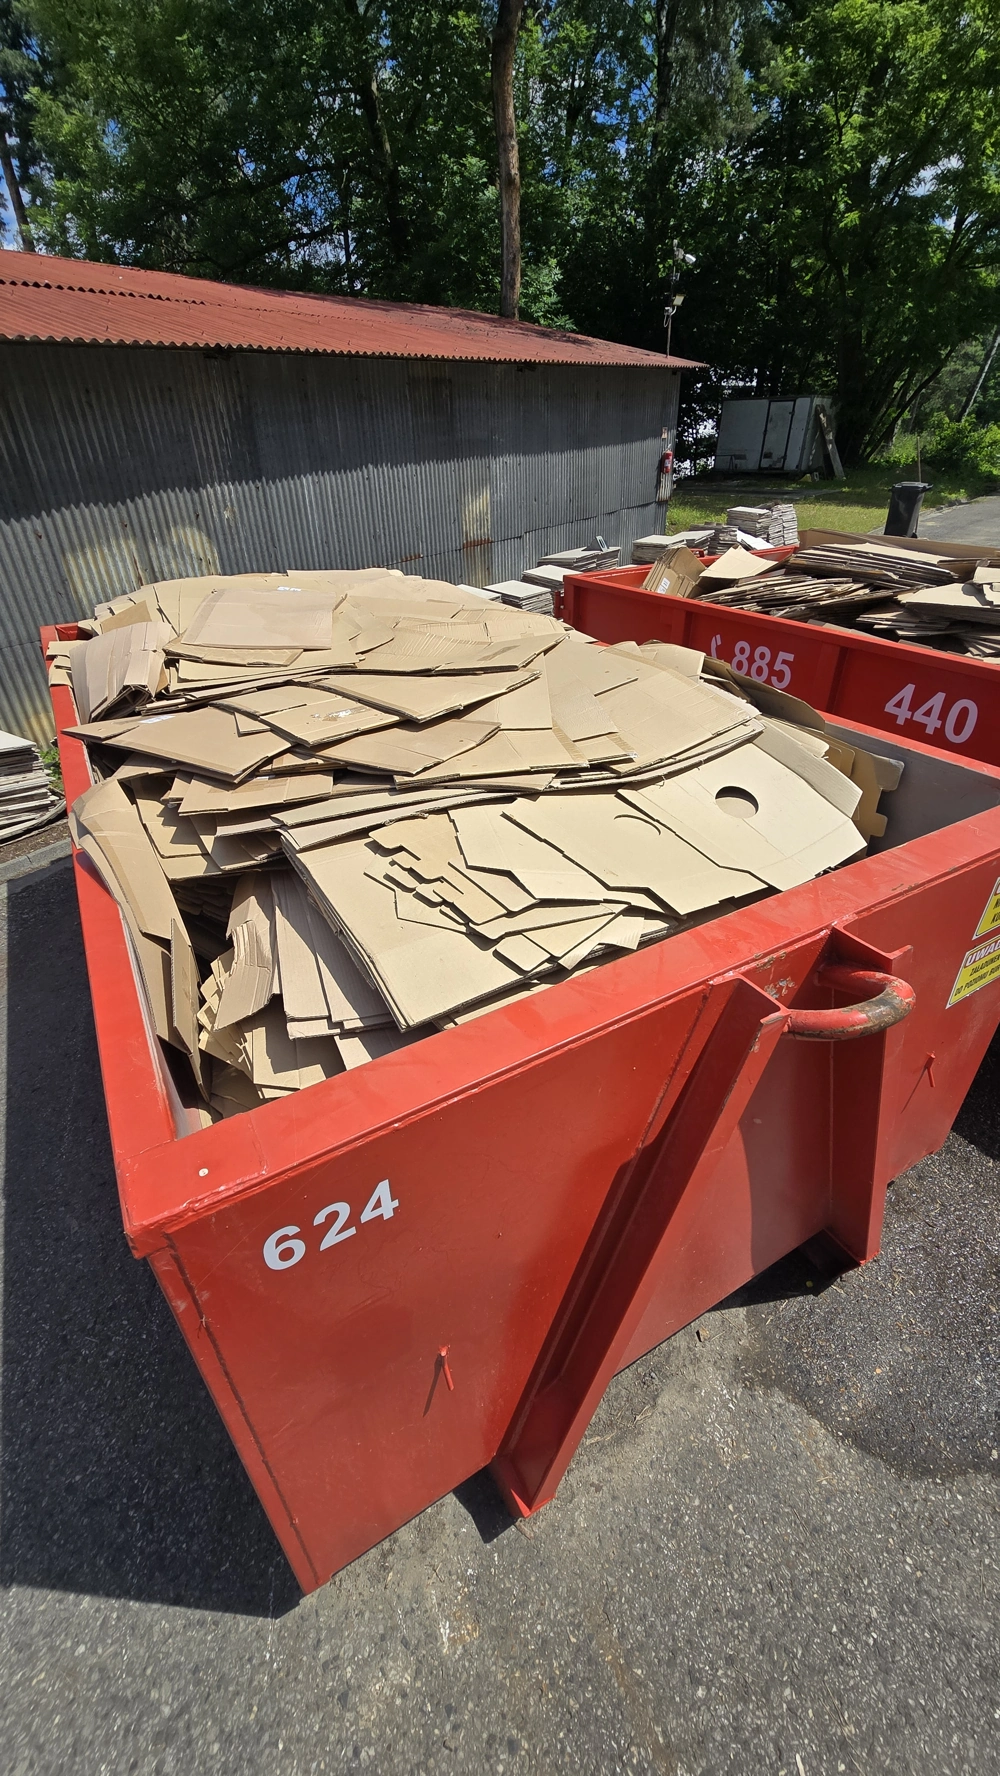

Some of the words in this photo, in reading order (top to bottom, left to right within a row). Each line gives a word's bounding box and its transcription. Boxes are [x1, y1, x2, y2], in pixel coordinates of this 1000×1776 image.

[731, 641, 795, 689] 885
[884, 683, 979, 744] 440
[263, 1179, 399, 1271] 624
